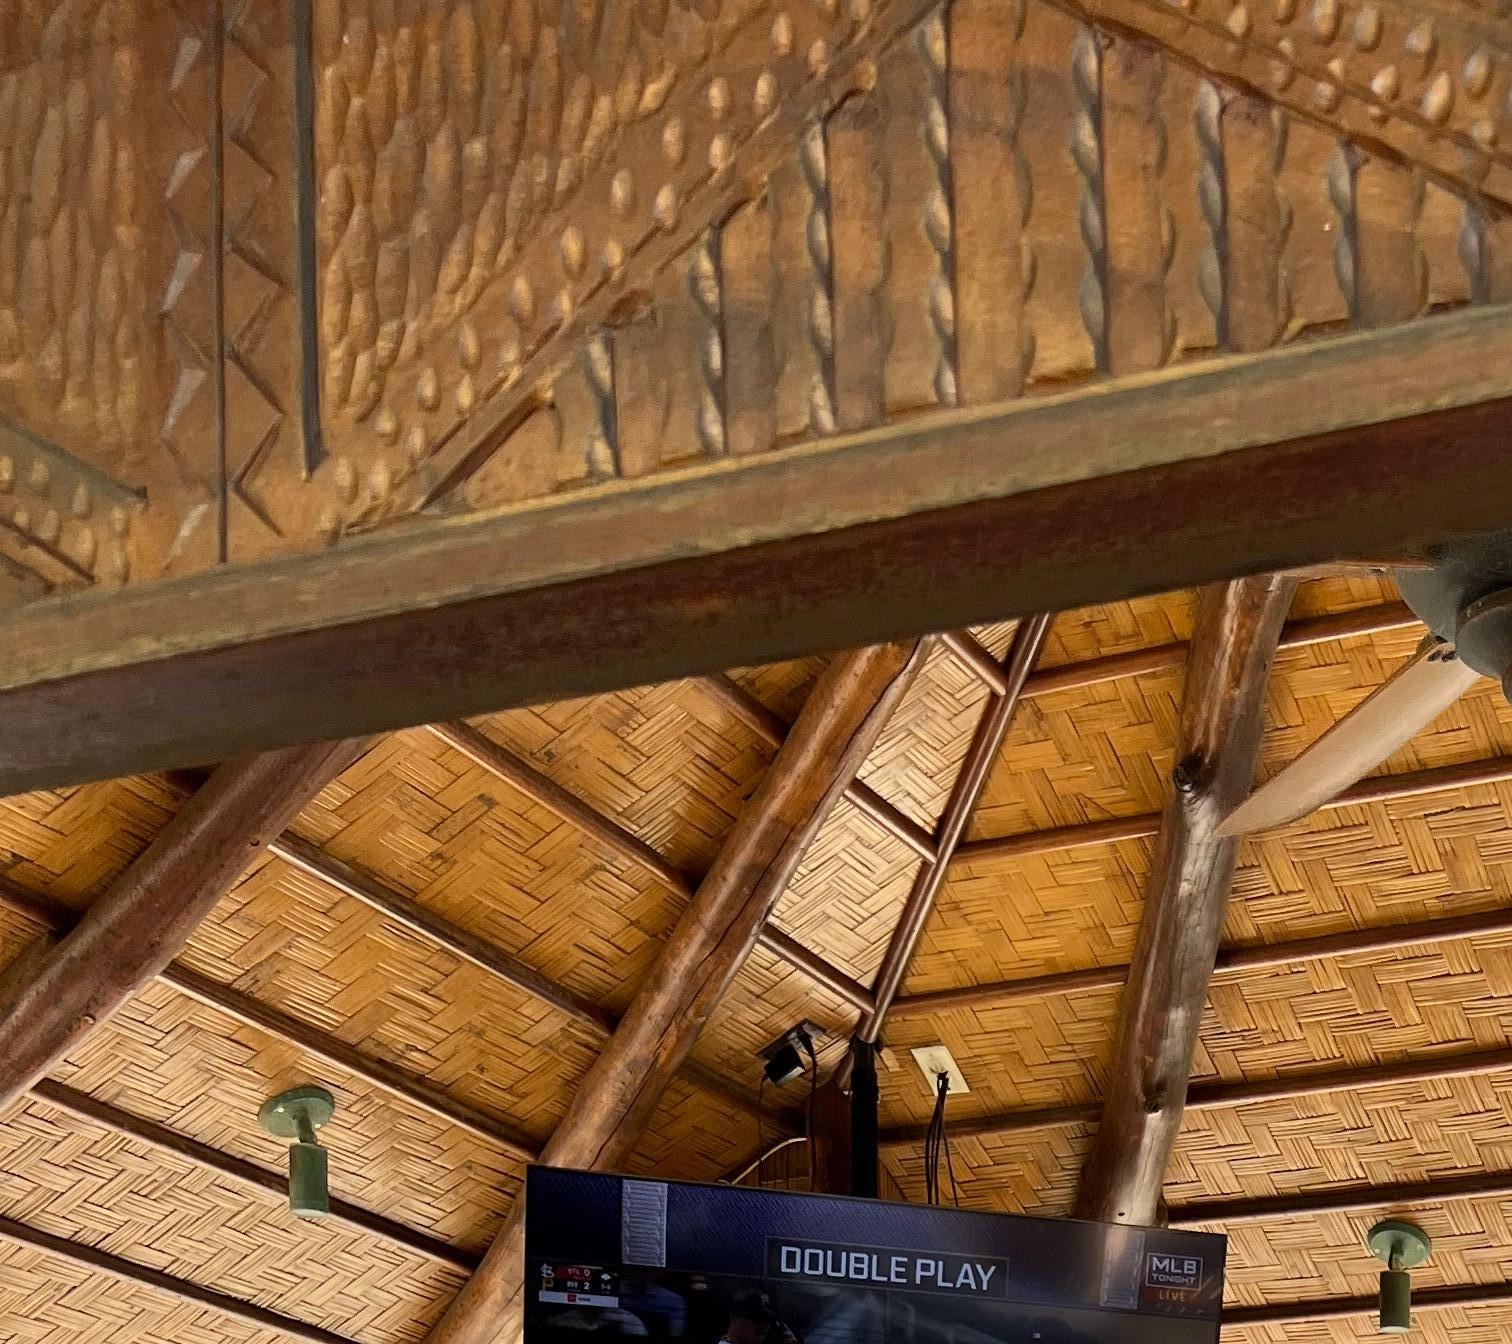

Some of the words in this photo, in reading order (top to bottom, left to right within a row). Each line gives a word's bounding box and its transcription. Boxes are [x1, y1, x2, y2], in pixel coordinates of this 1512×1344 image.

[780, 1245, 908, 1284] DOUBLE
[914, 1258, 997, 1291] PLAY
[1152, 1256, 1198, 1275] MLB
[1151, 1273, 1197, 1286] TONIGHT
[1158, 1291, 1187, 1303] LIVE
